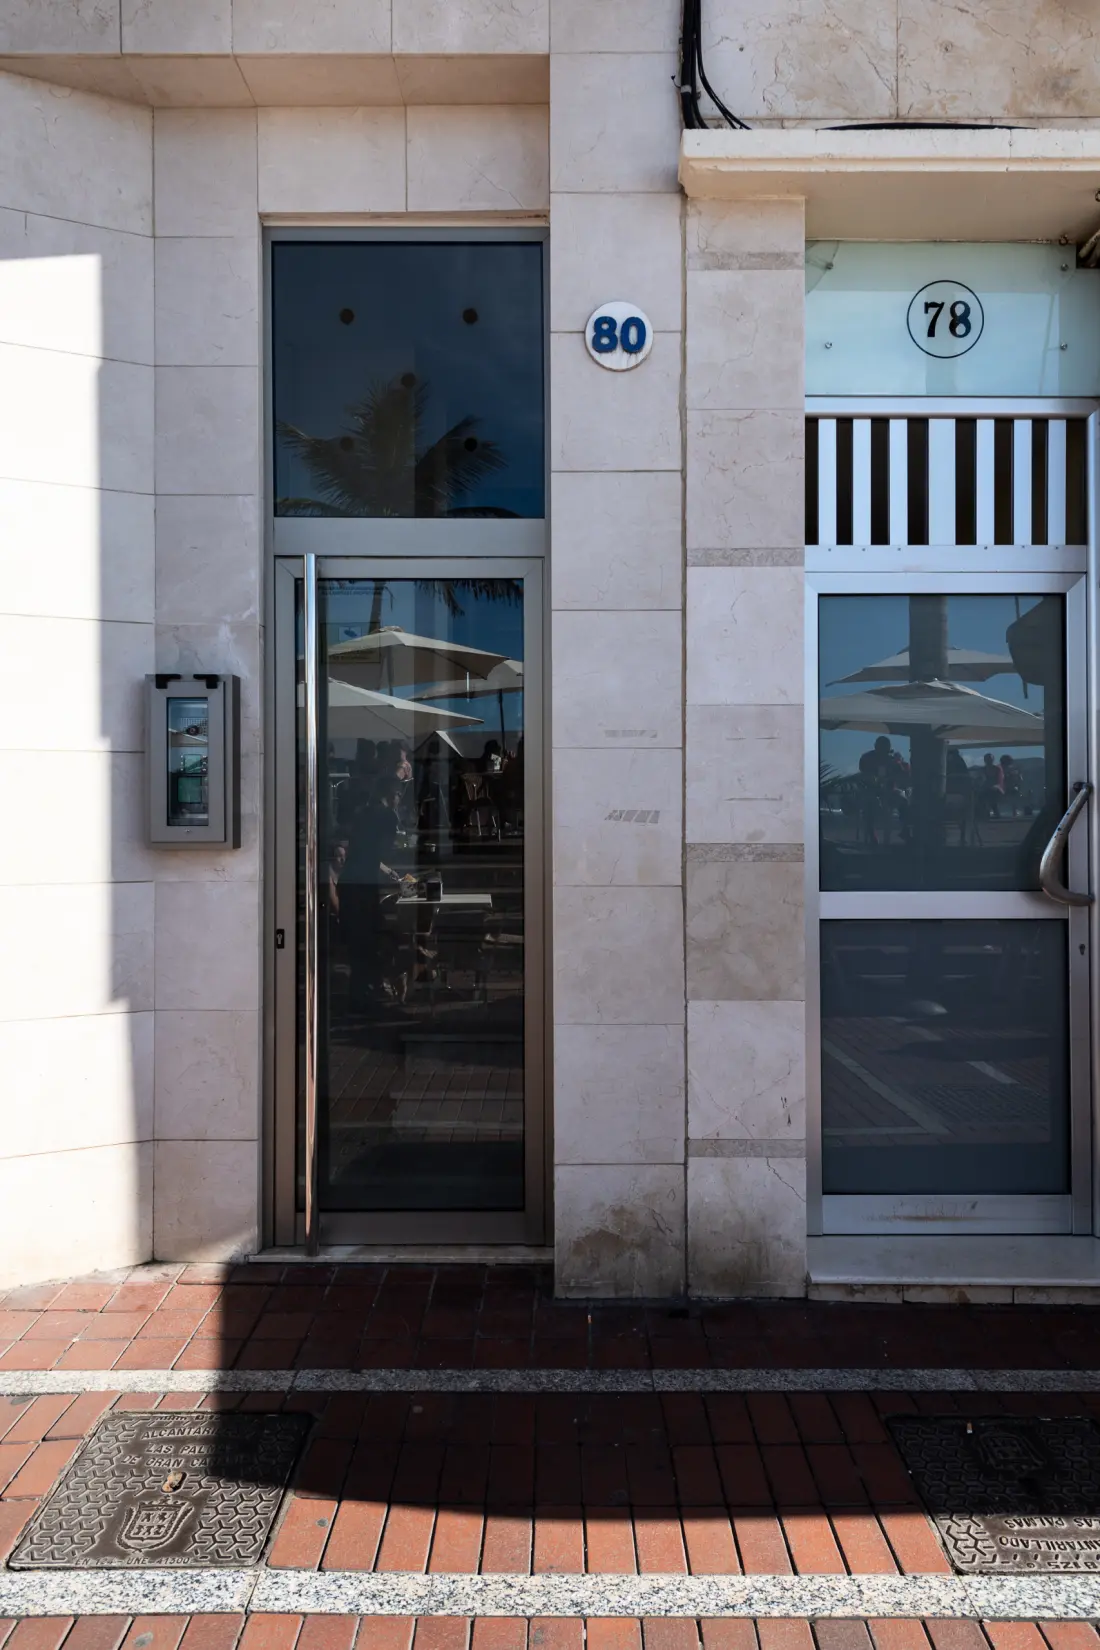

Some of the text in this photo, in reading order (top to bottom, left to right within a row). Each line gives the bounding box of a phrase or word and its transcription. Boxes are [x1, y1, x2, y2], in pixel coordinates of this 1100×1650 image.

[924, 301, 971, 338] 78
[592, 316, 646, 354] 80
[141, 1426, 250, 1440] ALCANTARIL
[146, 1443, 232, 1455] LAS PALM
[121, 1456, 139, 1465] DE
[145, 1458, 184, 1467] GRAN
[1004, 1516, 1065, 1529] PALMAS
